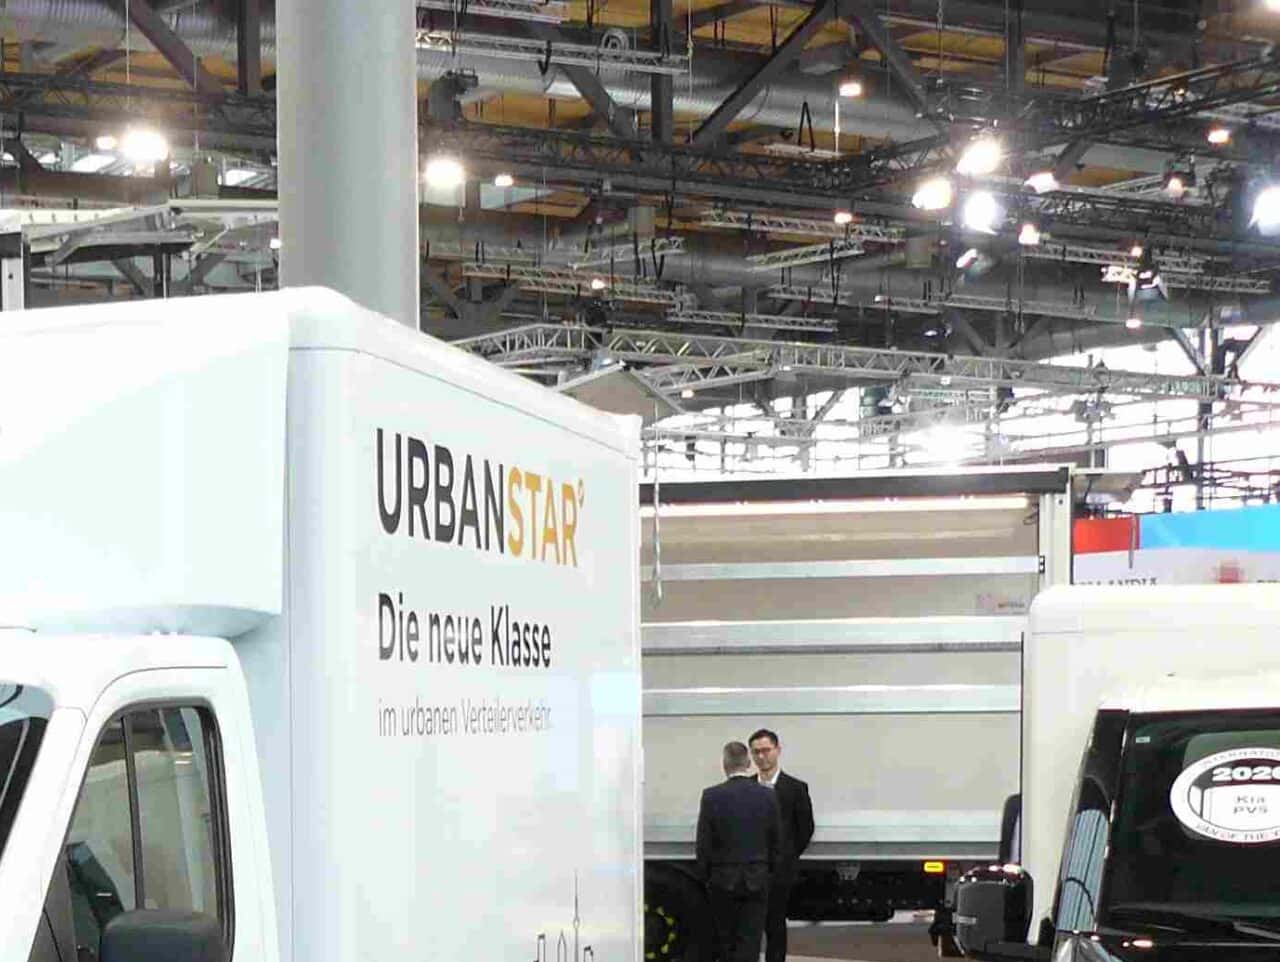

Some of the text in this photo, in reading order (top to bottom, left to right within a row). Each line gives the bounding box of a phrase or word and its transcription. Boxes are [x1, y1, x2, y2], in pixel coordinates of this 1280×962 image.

[378, 592, 551, 669] Die neue Klasse
[378, 698, 397, 737] im
[401, 696, 458, 737] urbanen
